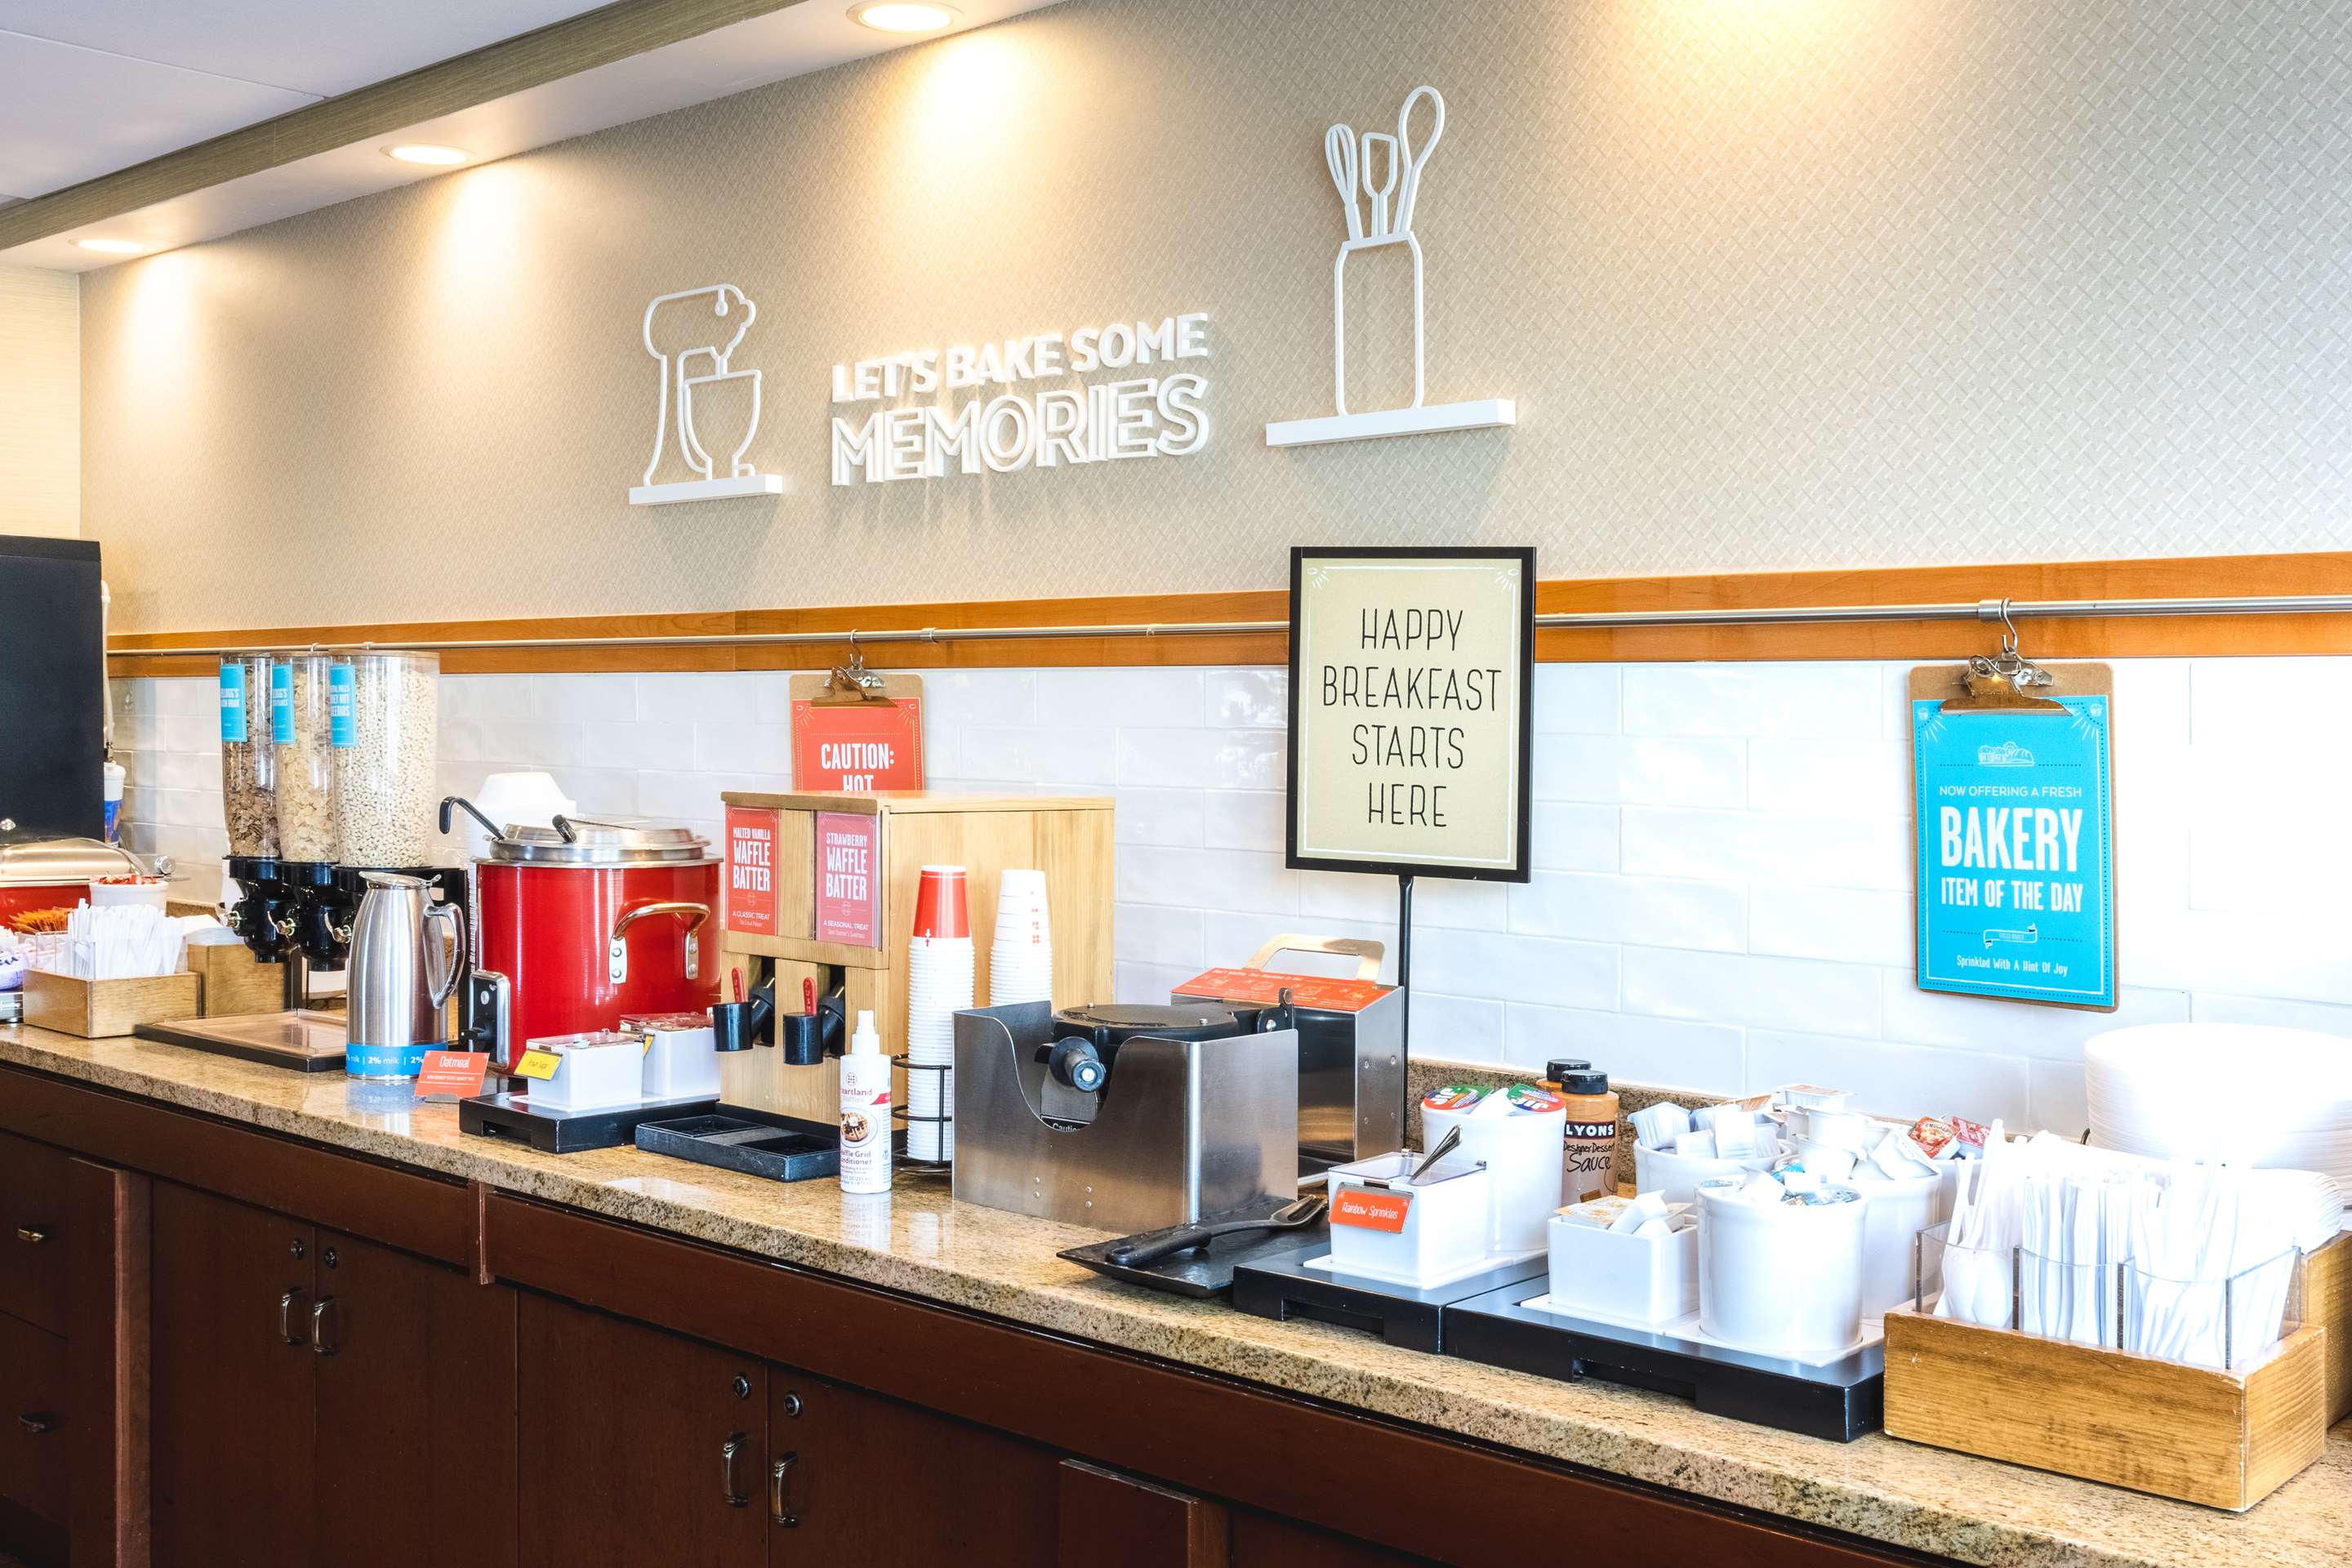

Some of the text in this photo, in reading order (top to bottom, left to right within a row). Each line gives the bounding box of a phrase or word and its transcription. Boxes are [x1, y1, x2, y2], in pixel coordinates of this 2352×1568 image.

[831, 312, 1209, 403] LET'S BAKE SOME
[831, 372, 1210, 486] MEMORIES
[1361, 608, 1463, 651] HAPPY
[1322, 665, 1502, 712] BREAKFAST
[821, 743, 895, 770] CAUTION:
[1352, 723, 1465, 769] STARTS
[842, 774, 875, 791] HOT
[1940, 786, 2082, 798] NOW OFFERING A FRESH
[1368, 782, 1448, 827] HERE
[733, 826, 771, 840] MALTED VANILLA
[826, 831, 868, 848] STRAWBERRY
[1940, 805, 2083, 872] BAKERY
[733, 840, 772, 866] WAFFLE
[826, 846, 868, 875] WAFFLE
[733, 865, 771, 893] BATTER
[825, 873, 868, 902] BATTER
[1940, 877, 2084, 913] ITEM OF THE DAY
[737, 911, 756, 920] CLASSIC
[755, 913, 771, 921] TREAT
[827, 920, 853, 930] SEASONAL
[853, 923, 870, 931] TREAT
[1993, 957, 2011, 971] With
[2013, 960, 2020, 971] A
[2023, 960, 2039, 973] Hint
[2042, 961, 2051, 973] Of
[2053, 963, 2069, 978] Joy
[368, 1056, 382, 1064] 2%
[383, 1056, 399, 1064] milk
[439, 1055, 471, 1068] Oatmeal
[1052, 1122, 1081, 1133] Cautio
[1566, 1124, 1615, 1137] LYONS
[854, 1150, 871, 1158] Grid
[1563, 1139, 1592, 1156] Designer
[1566, 1152, 1612, 1173] Sauce
[1341, 1201, 1399, 1219] Rainbow Sprinkles
